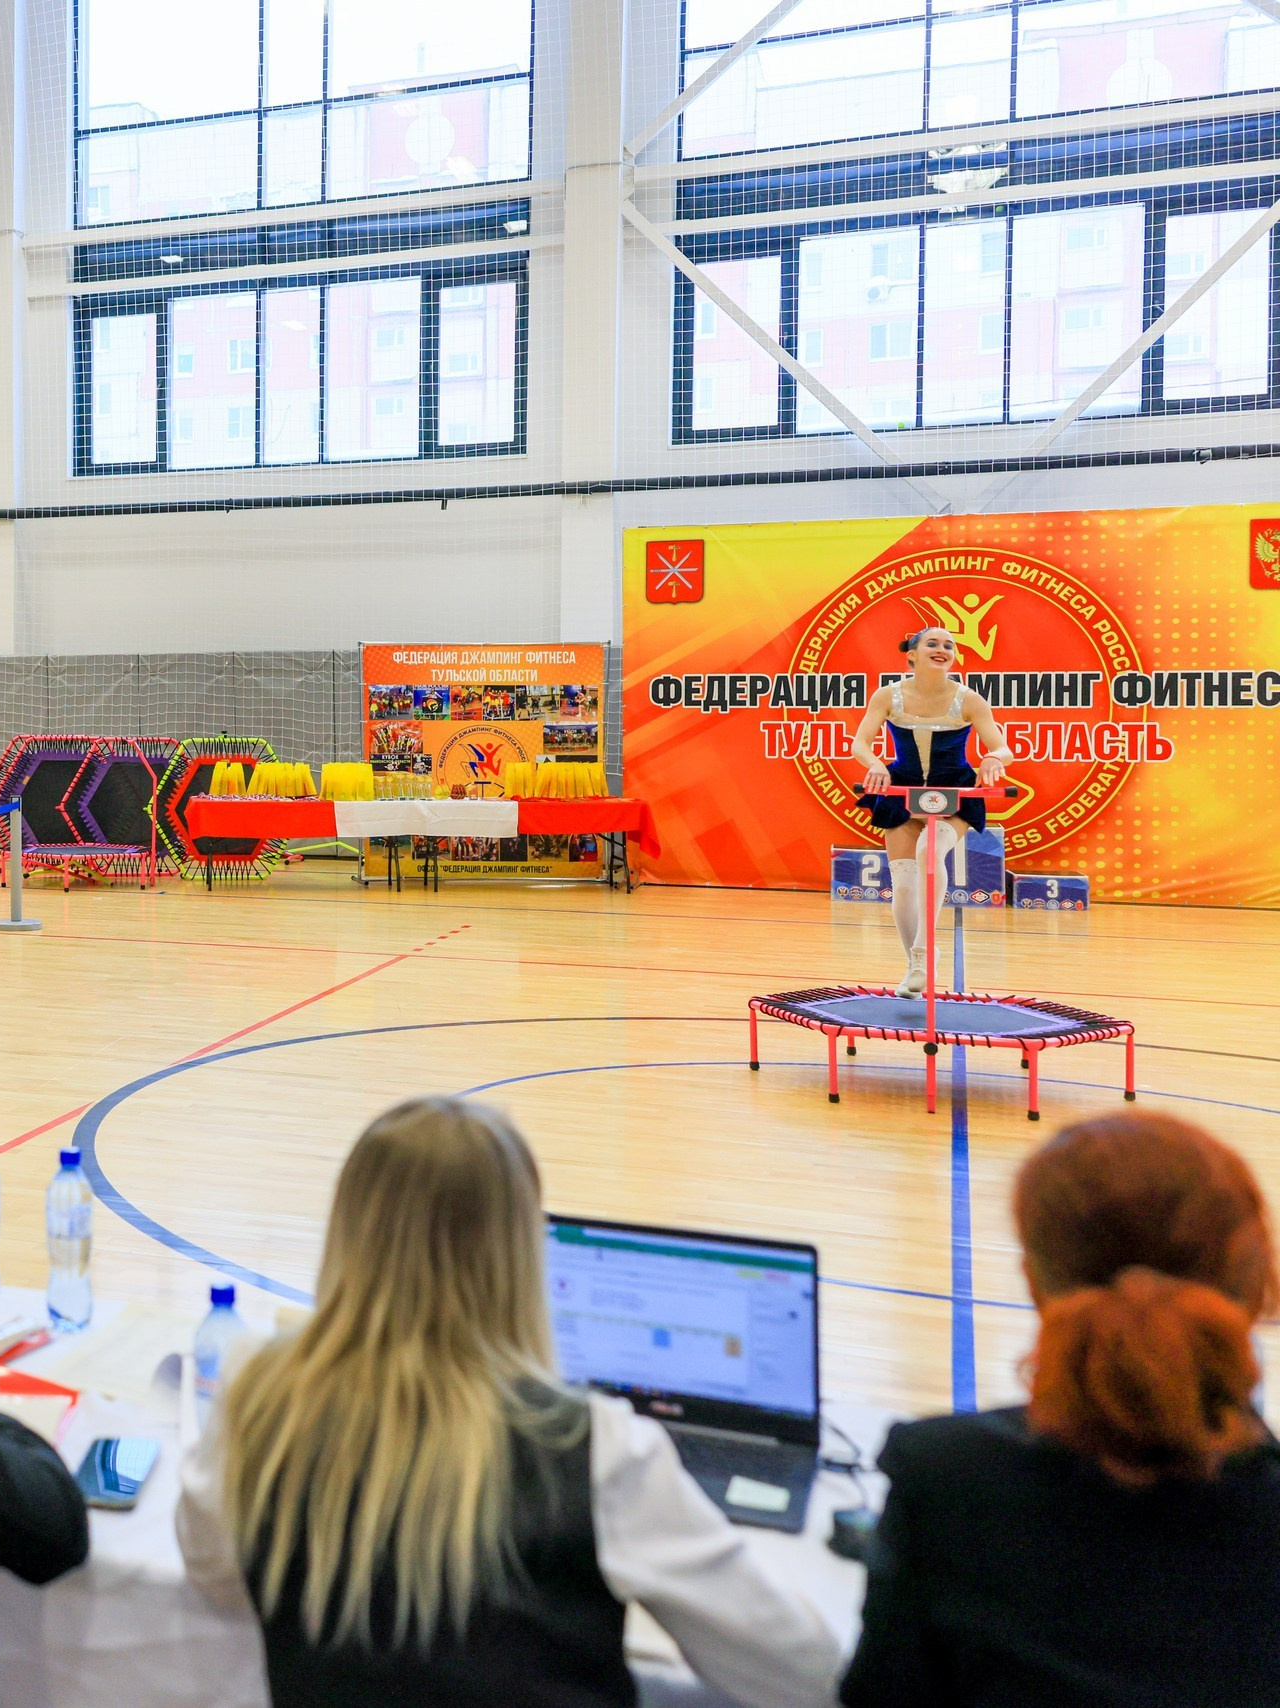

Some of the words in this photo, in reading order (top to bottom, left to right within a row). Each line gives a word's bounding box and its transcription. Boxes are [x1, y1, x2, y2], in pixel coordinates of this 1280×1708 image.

[798, 593, 862, 675] ДЕРАЦИЯ
[864, 556, 995, 600] ДЖАМПИНГ
[1001, 561, 1097, 621] ФИТНЕСА
[392, 651, 458, 666] ФЕДЕРАЦИЯ
[460, 650, 523, 666] ДЖАМПИНГ
[525, 650, 576, 665] ФИТНЕСА
[430, 667, 487, 682] ТУЛЬСКОЙ
[489, 669, 538, 682] ОБЛАСТИ
[650, 673, 867, 713] ФЕДЕРАЦИЯ
[458, 727, 492, 739] ДЖАМПИНГ
[493, 729, 517, 747] ФИТНЕСА
[440, 865, 481, 873] "ФЕДЕРАЦИЯ
[482, 865, 518, 873] ДЖАМПИНГ
[520, 865, 553, 873] ФИТНЕСА"
[861, 854, 881, 887] 2
[1046, 880, 1058, 898] 3
